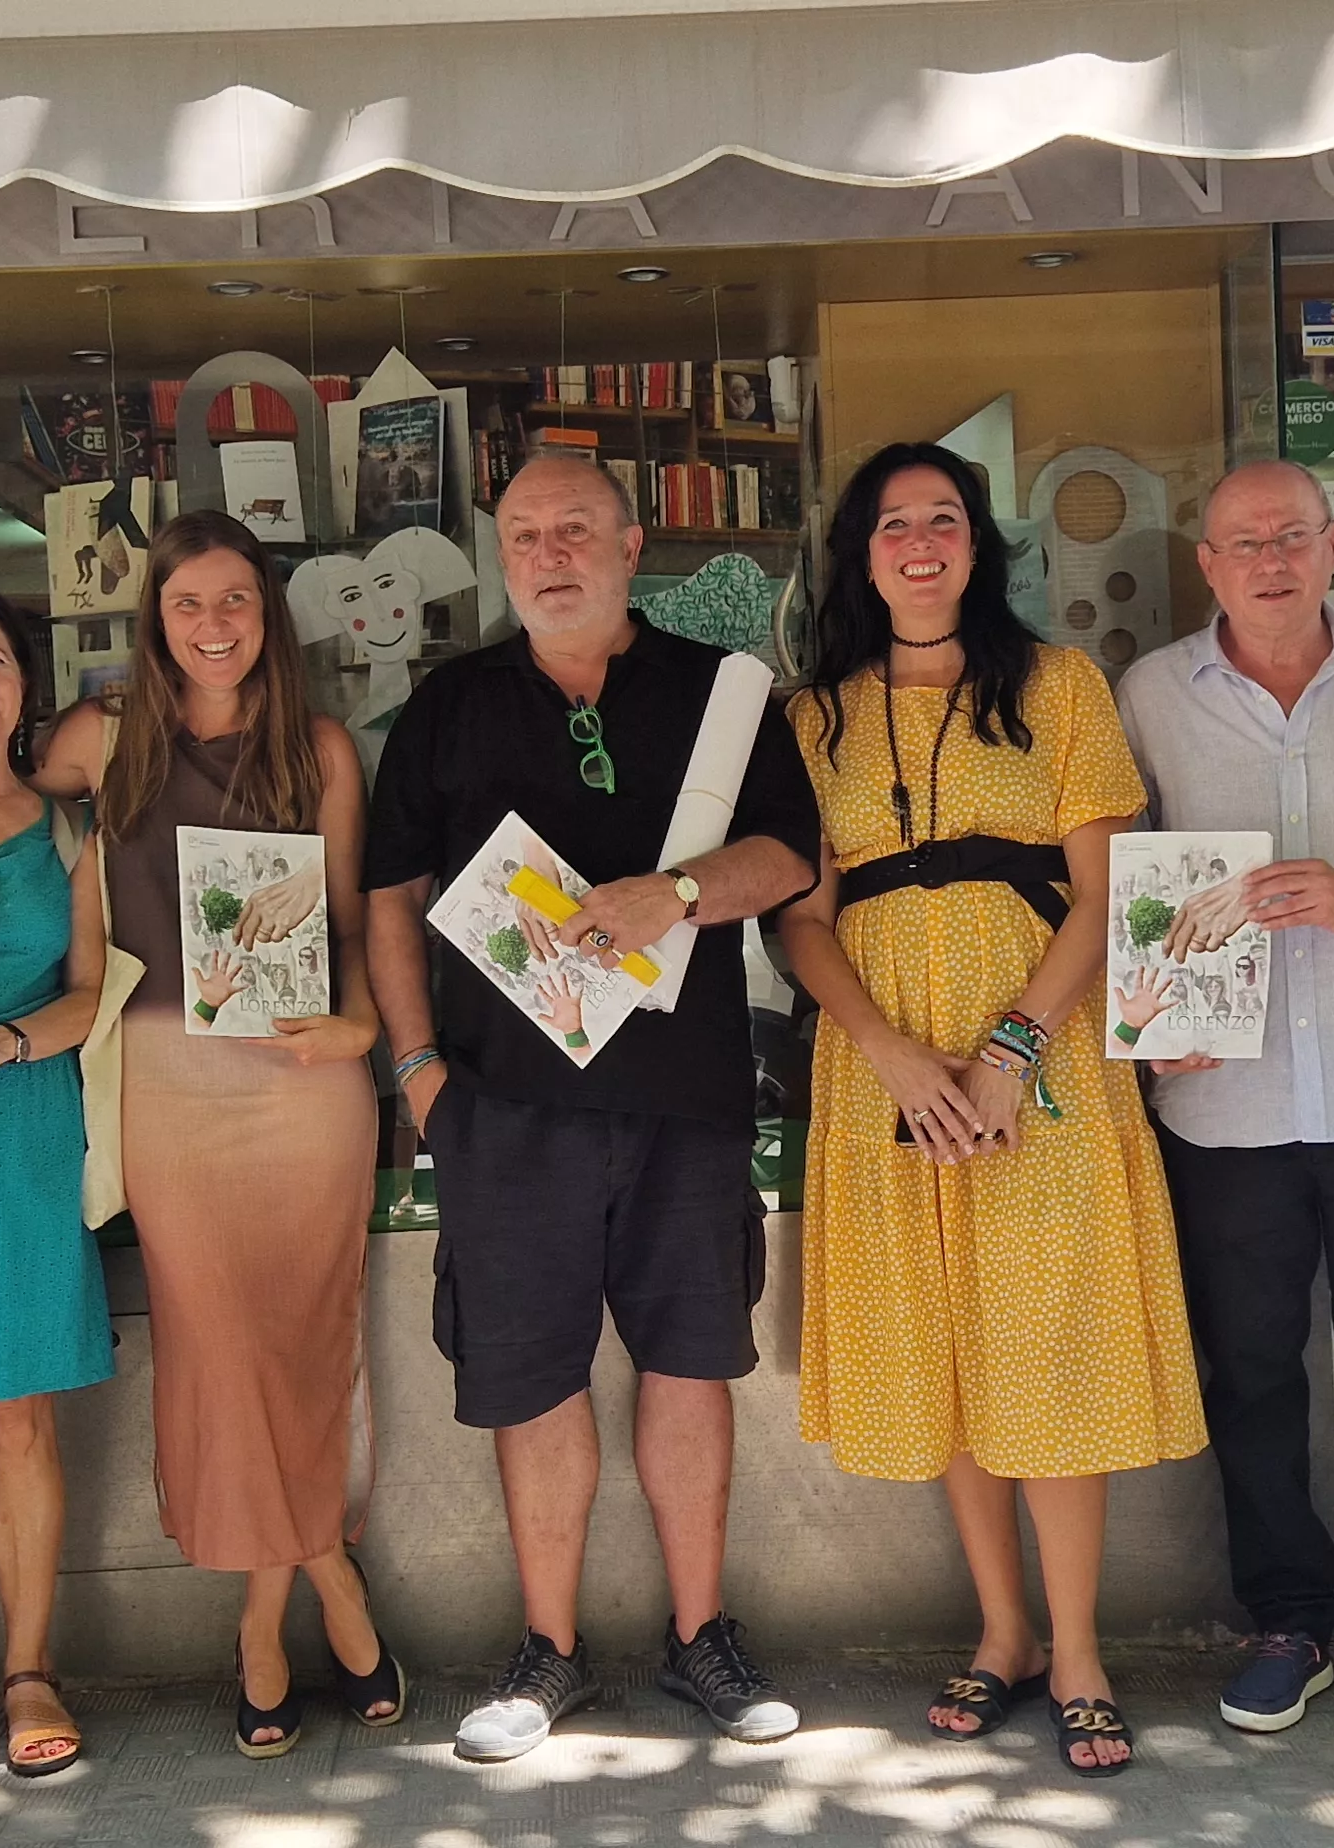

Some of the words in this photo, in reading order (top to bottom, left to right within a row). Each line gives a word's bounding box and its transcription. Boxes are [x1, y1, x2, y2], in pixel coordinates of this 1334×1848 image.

[1286, 412, 1324, 425] MIGO
[500, 455, 510, 481] MARX
[239, 998, 322, 1016] LORENZO
[1166, 1014, 1258, 1032] LORENZO
